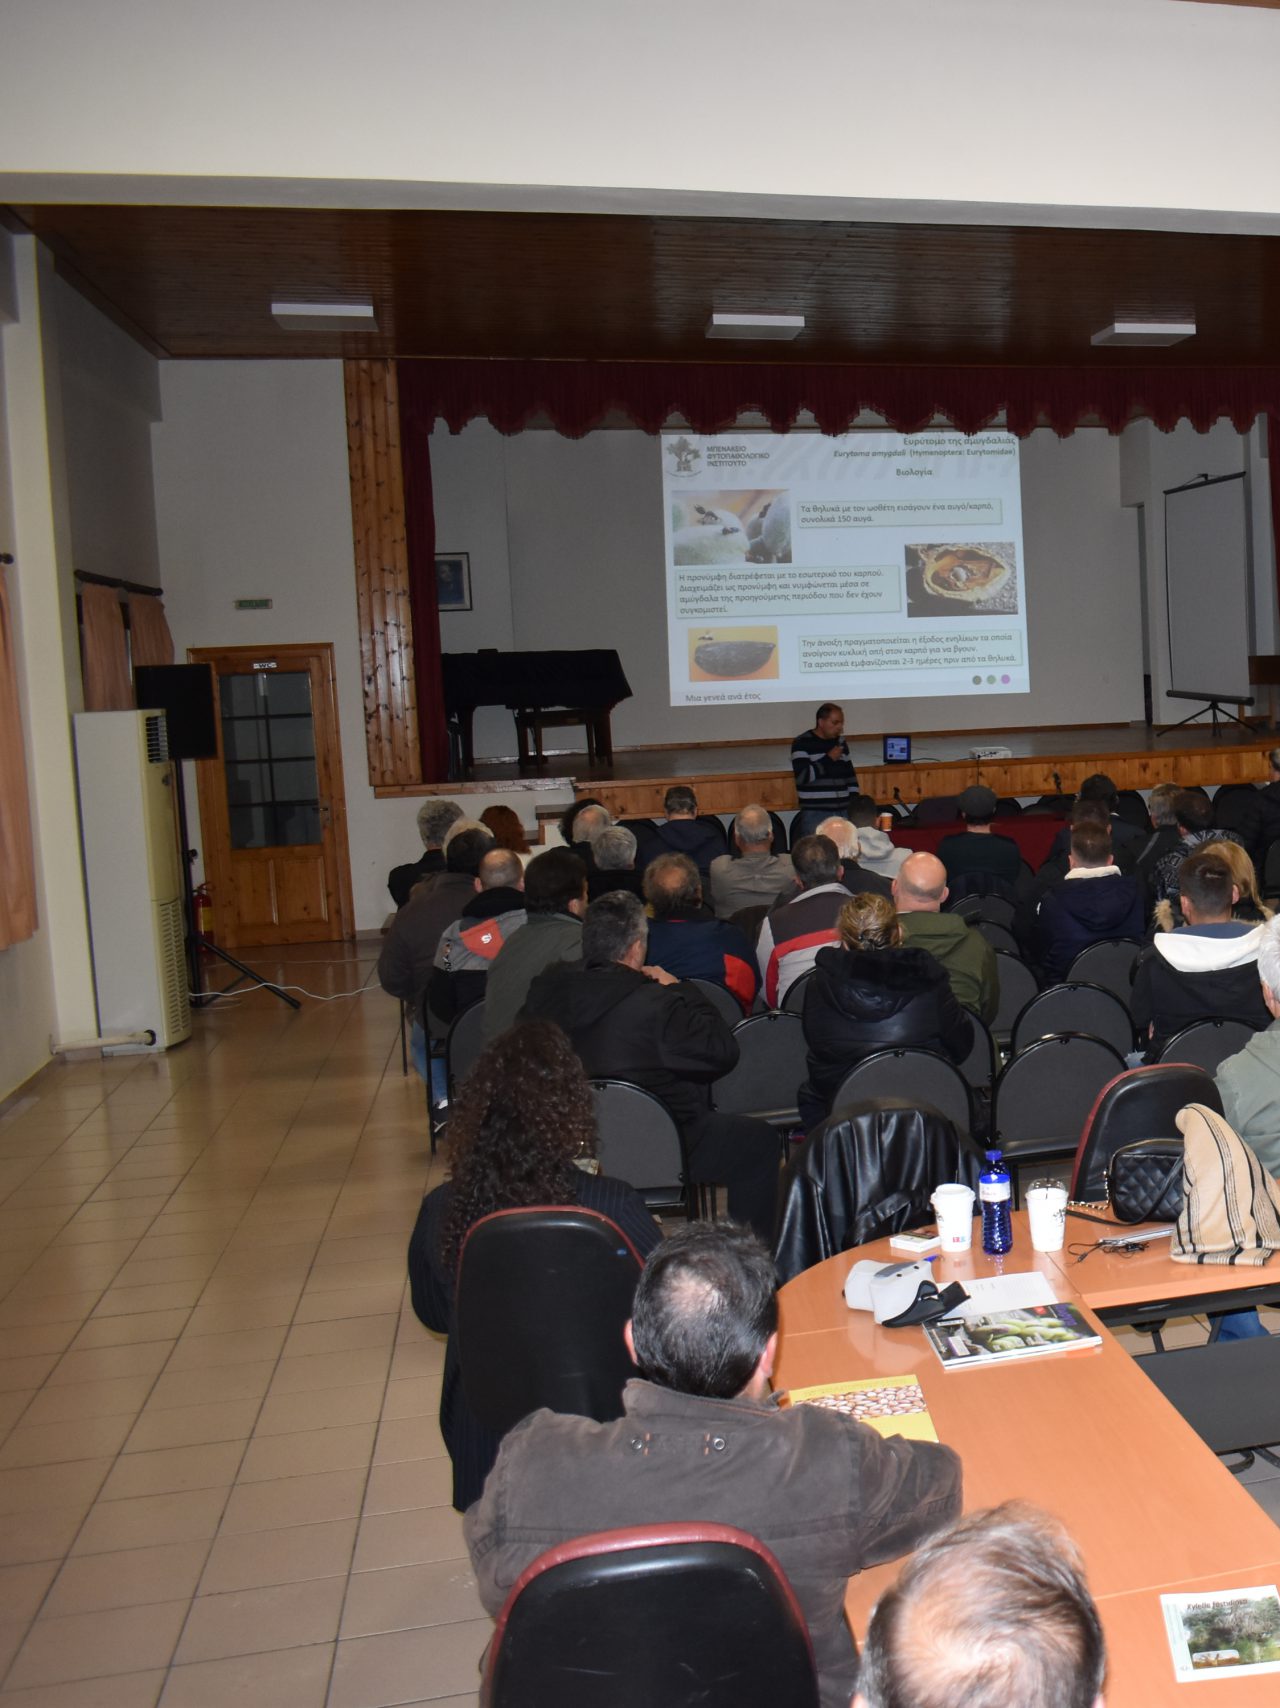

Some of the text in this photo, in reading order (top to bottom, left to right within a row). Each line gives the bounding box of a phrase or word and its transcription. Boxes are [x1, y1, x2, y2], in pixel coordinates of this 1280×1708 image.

[948, 438, 962, 446] της
[896, 468, 933, 477] Βιολογία
[800, 505, 811, 513] Τα
[812, 504, 840, 513] θηλυκά
[838, 515, 852, 523] 150
[777, 572, 786, 580] με
[838, 570, 852, 578] του
[846, 591, 859, 599] δεν
[802, 639, 816, 648] Την
[929, 646, 943, 654] για
[802, 661, 813, 669] Τα
[902, 657, 914, 665] 2-3
[685, 694, 702, 702] Μια
[744, 692, 761, 701] έτος
